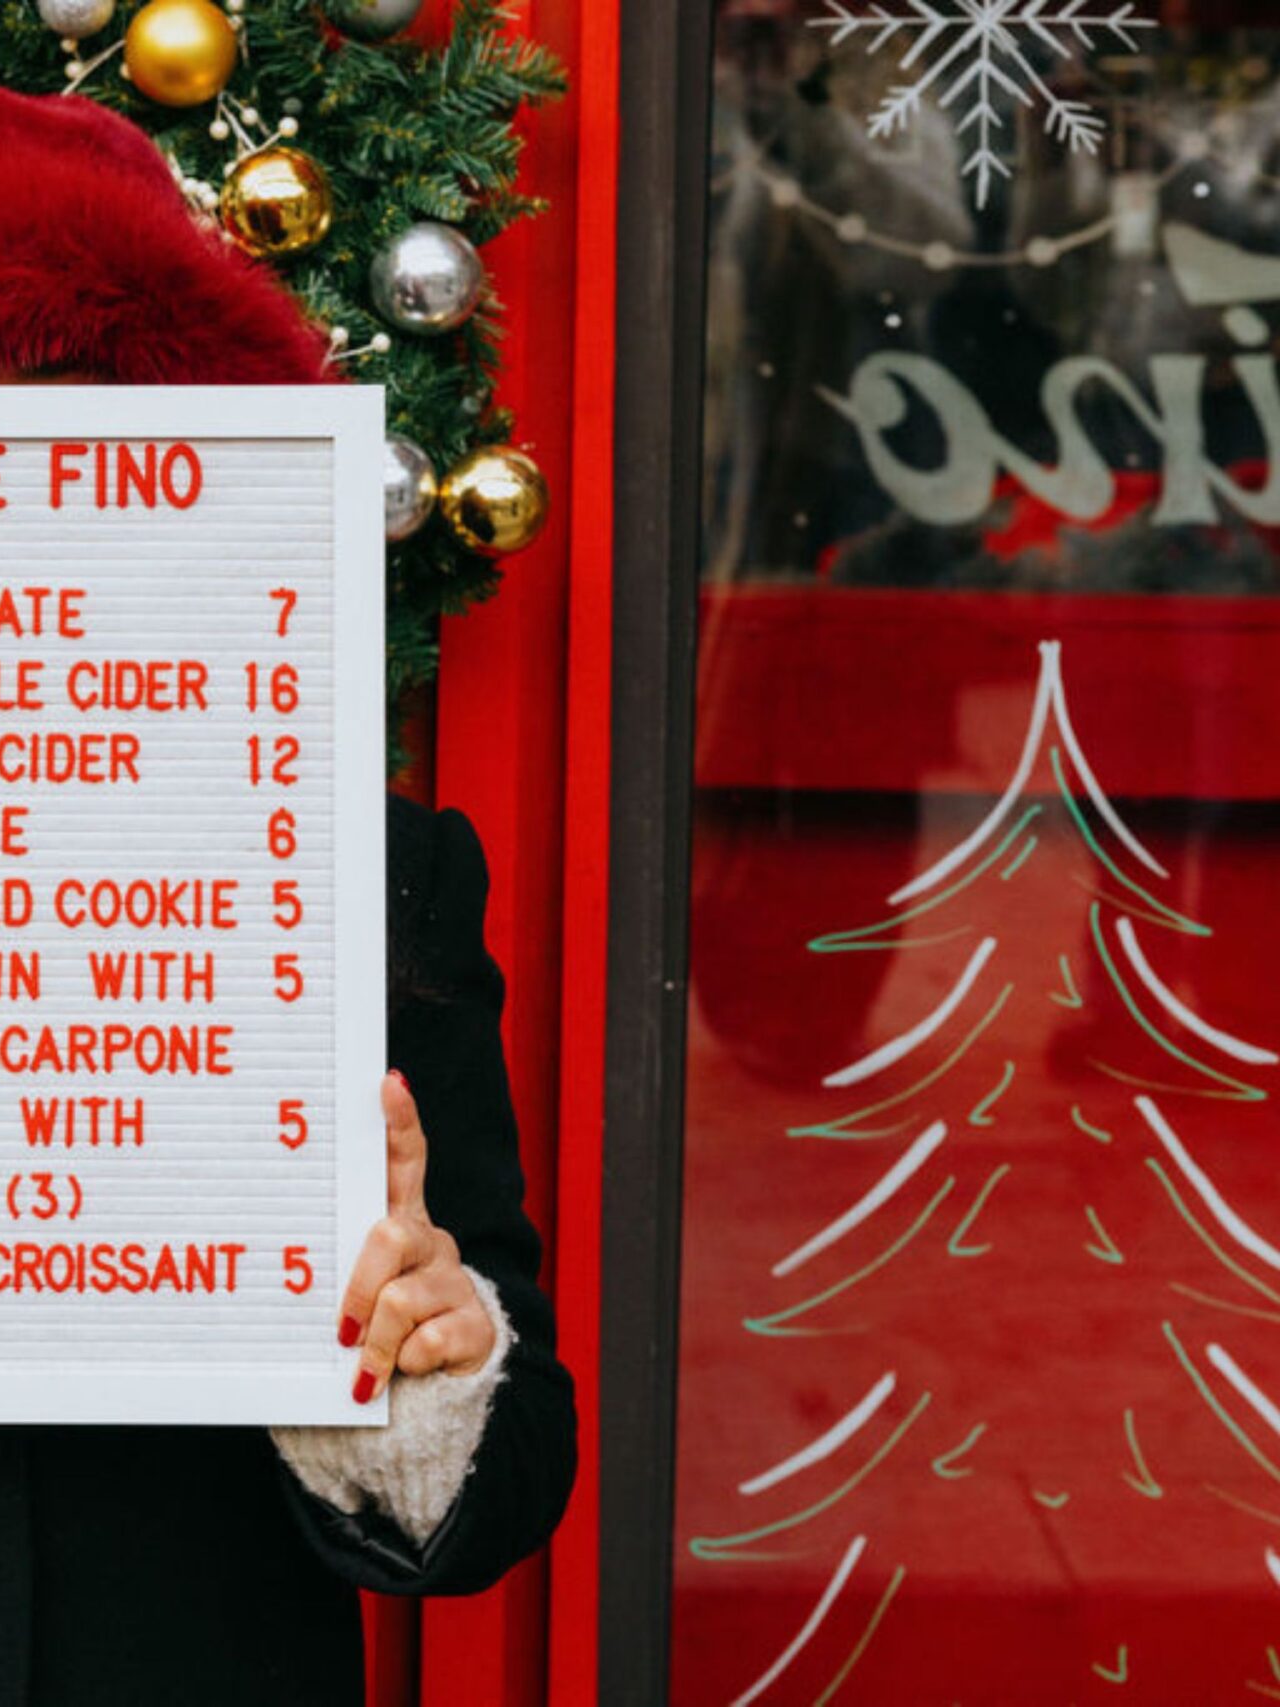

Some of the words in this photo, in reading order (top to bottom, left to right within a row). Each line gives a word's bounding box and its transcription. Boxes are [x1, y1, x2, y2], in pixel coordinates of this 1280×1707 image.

[49, 441, 204, 511] FINO
[269, 587, 298, 638] 7
[66, 659, 209, 713] CIDER
[245, 662, 300, 714] 16
[247, 734, 301, 787] 12
[267, 806, 297, 860] 6
[53, 878, 239, 930] COOKIE
[272, 879, 303, 930] 5
[87, 951, 214, 1003] WITH
[273, 953, 304, 1003] 5
[19, 1095, 145, 1149] WITH
[278, 1099, 309, 1151] 5
[6, 1171, 83, 1220] (3)
[282, 1245, 314, 1295] 5
